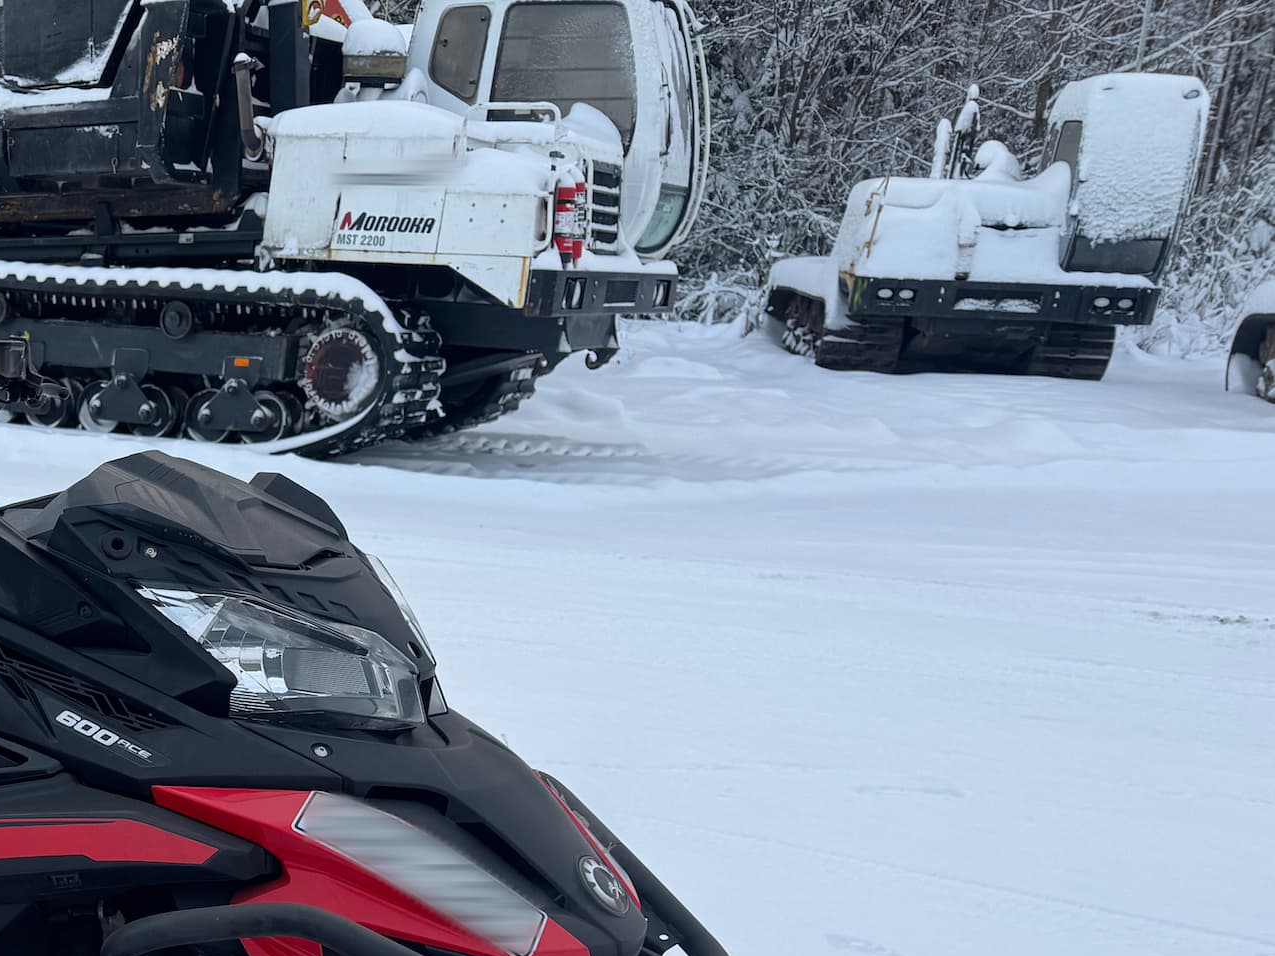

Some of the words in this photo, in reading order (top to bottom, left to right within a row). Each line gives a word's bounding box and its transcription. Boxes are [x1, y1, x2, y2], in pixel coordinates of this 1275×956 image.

[340, 211, 436, 234] MOROOKA
[336, 234, 359, 246] MST
[360, 235, 386, 247] 2200
[55, 710, 120, 747] 600
[116, 738, 153, 760] ACE
